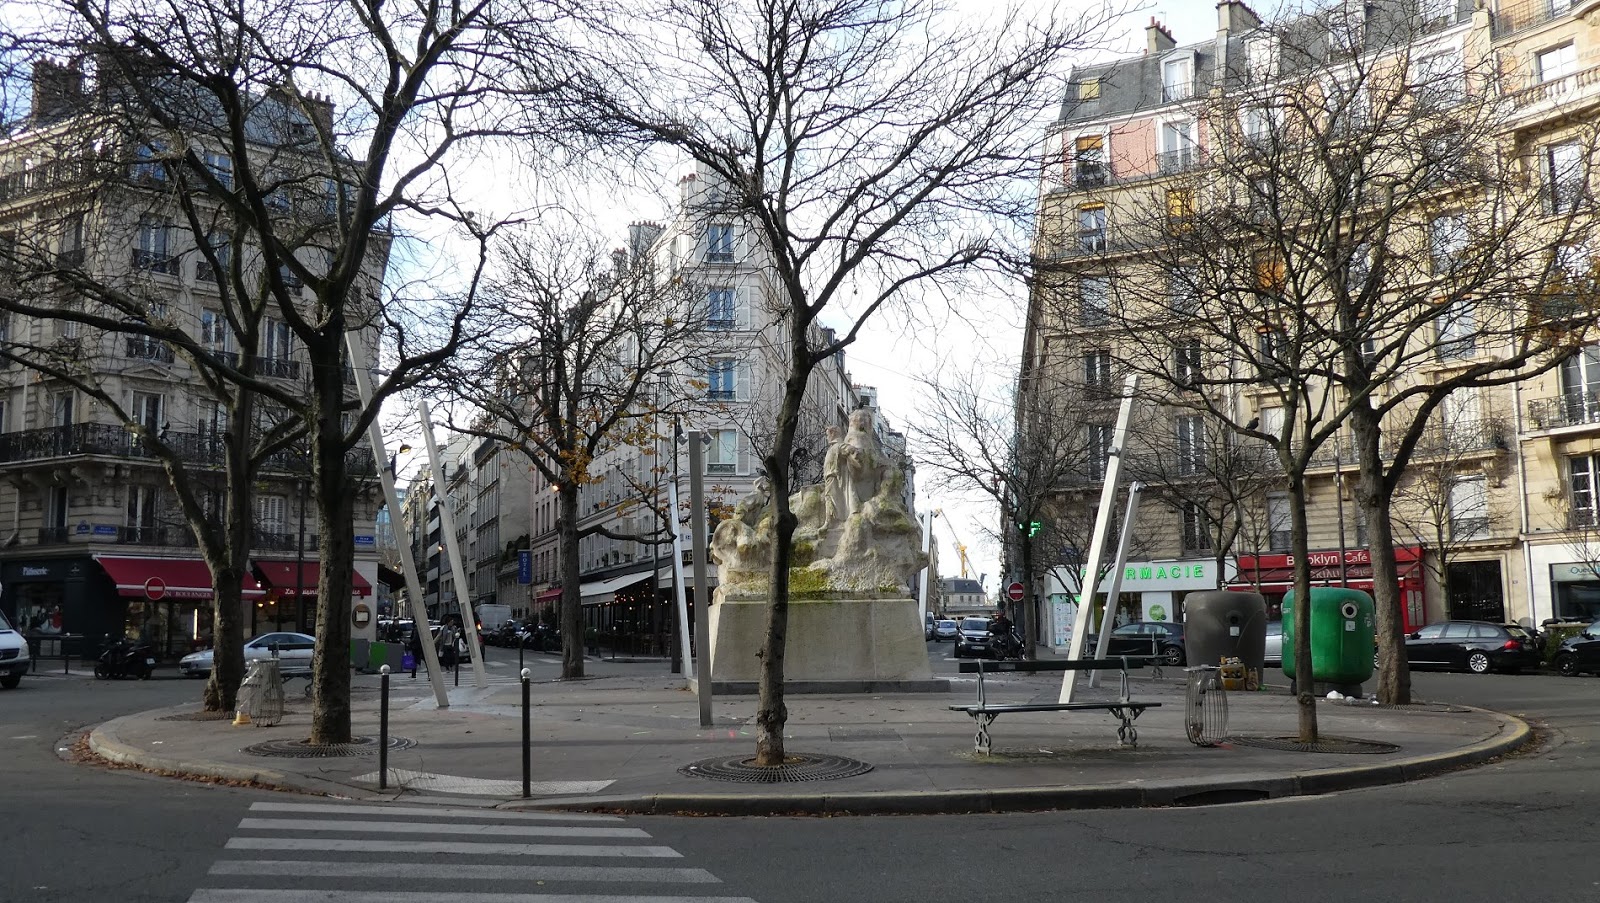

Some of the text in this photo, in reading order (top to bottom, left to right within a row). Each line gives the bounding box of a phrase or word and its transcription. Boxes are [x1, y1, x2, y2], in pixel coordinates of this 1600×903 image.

[1286, 552, 1368, 566] Boklyn Café
[1081, 565, 1204, 581] RMACIE
